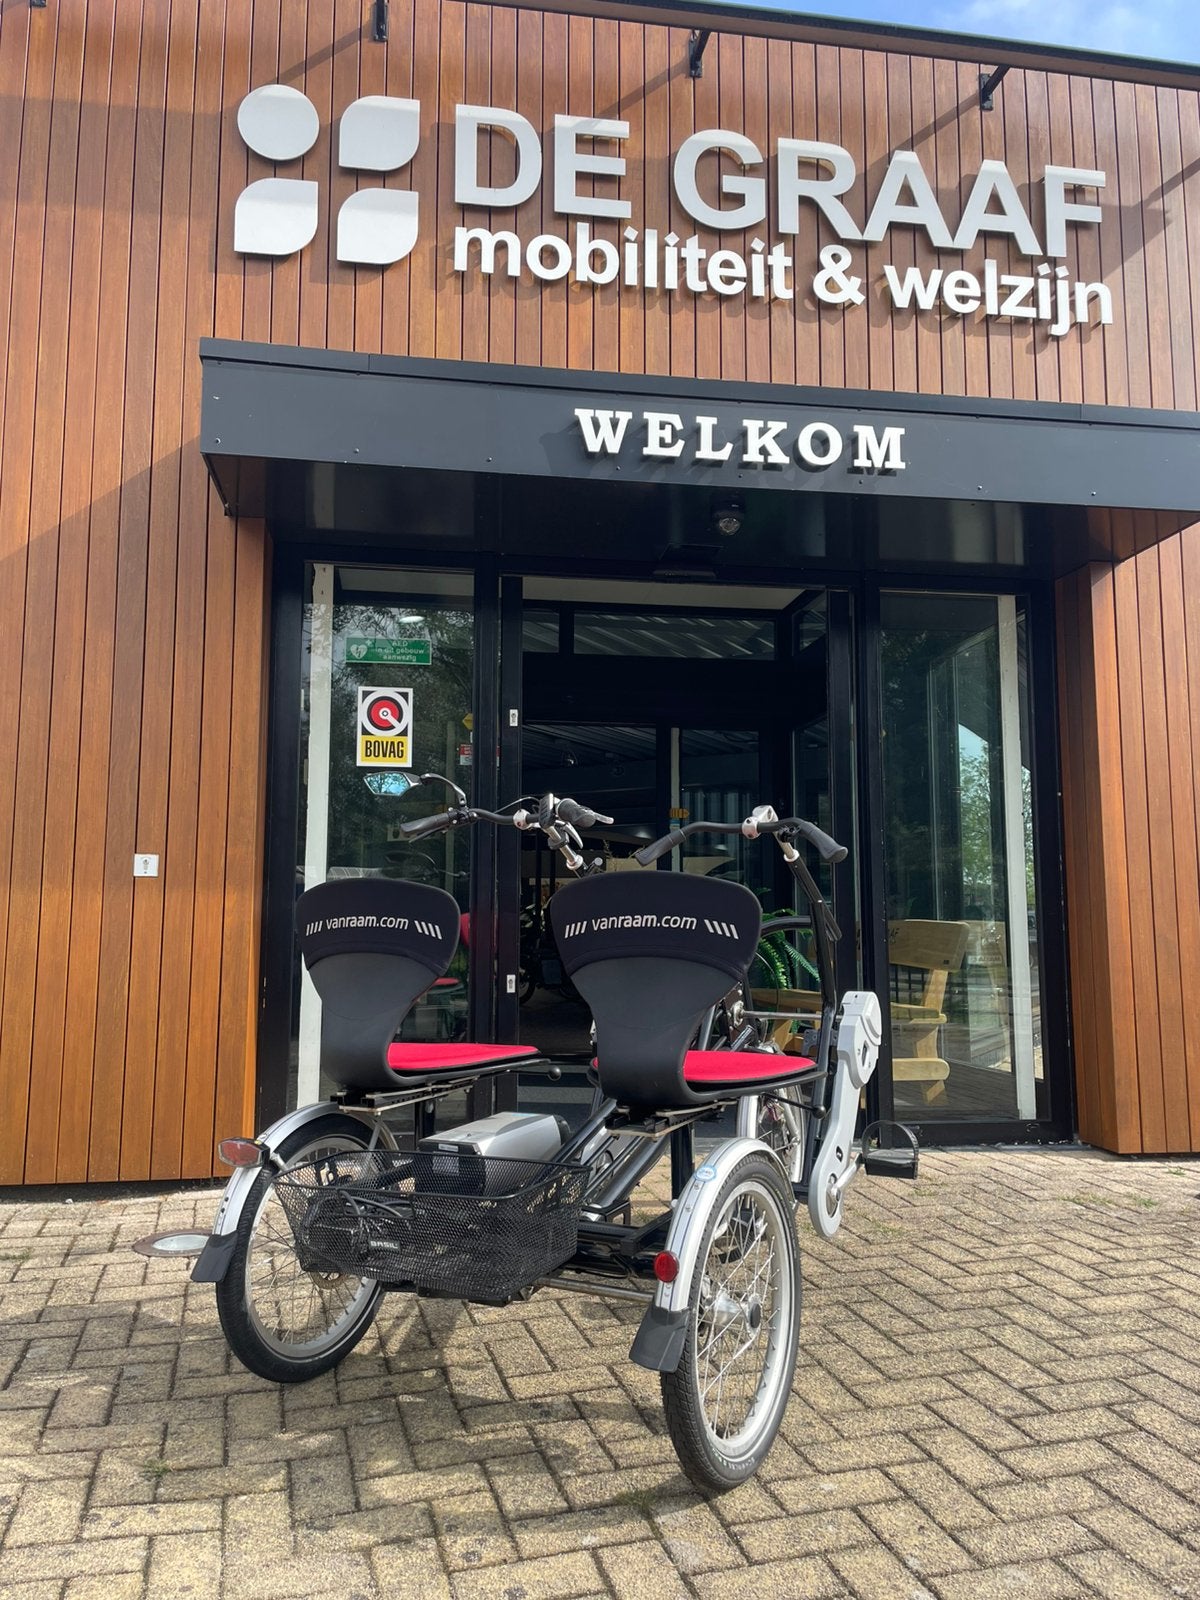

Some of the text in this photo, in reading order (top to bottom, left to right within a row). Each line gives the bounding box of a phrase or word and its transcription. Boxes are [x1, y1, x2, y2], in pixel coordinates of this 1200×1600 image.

[454, 103, 1107, 258] DE GRAAF
[453, 220, 1114, 338] mobiliteit & welzijn
[574, 408, 906, 470] WELKOM
[396, 647, 425, 655] gebouw
[365, 740, 404, 759] BOVAG
[326, 915, 409, 930] vanraam.com
[592, 914, 697, 931] vanraam.com
